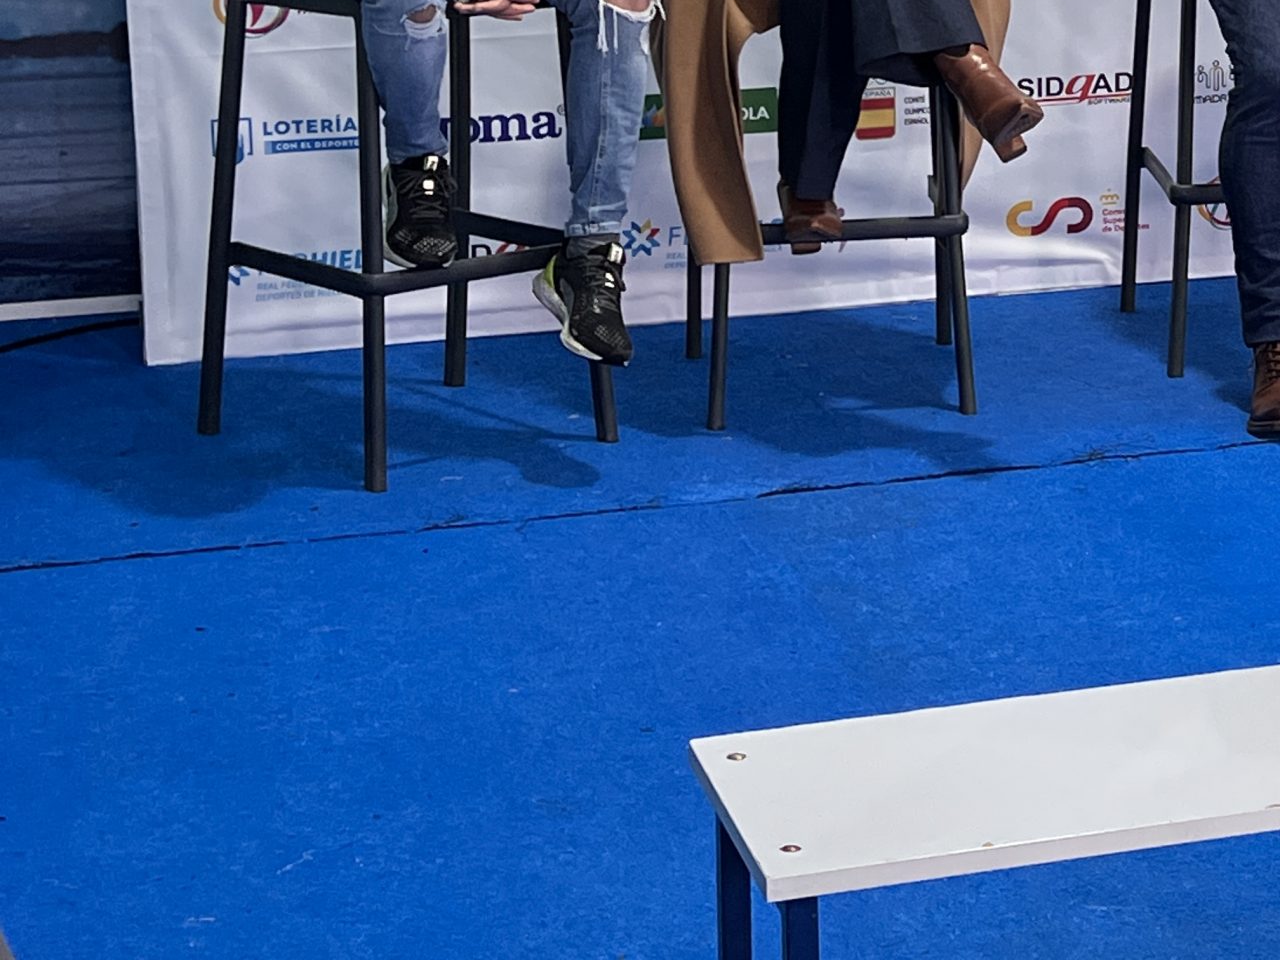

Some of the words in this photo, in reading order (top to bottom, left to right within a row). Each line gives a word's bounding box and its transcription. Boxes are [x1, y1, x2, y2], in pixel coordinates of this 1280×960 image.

[262, 114, 358, 136] LOTERÍA
[275, 142, 298, 151] CON
[300, 141, 312, 150] EL
